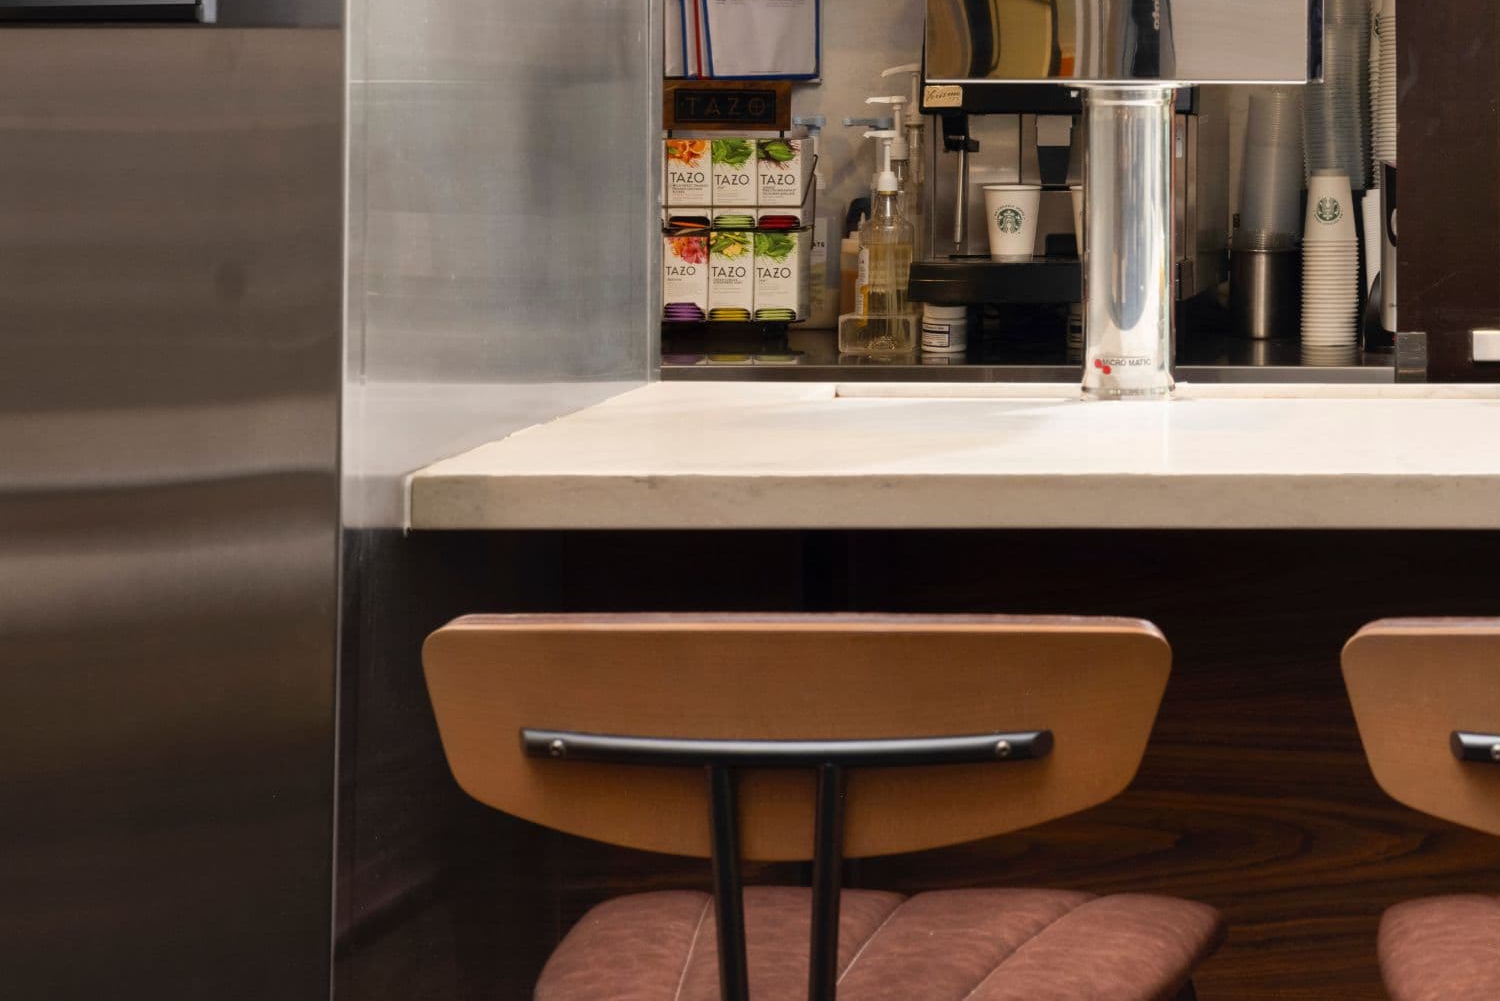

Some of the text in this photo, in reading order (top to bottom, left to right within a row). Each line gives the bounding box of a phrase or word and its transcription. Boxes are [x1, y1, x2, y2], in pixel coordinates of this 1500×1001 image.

[684, 97, 766, 116] TAZO
[670, 172, 705, 184] TAZO
[715, 174, 749, 186] TAZO
[760, 174, 795, 186] TAZO
[666, 266, 696, 277] TAZO
[711, 266, 746, 279] TAZO
[757, 267, 791, 280] TAZO
